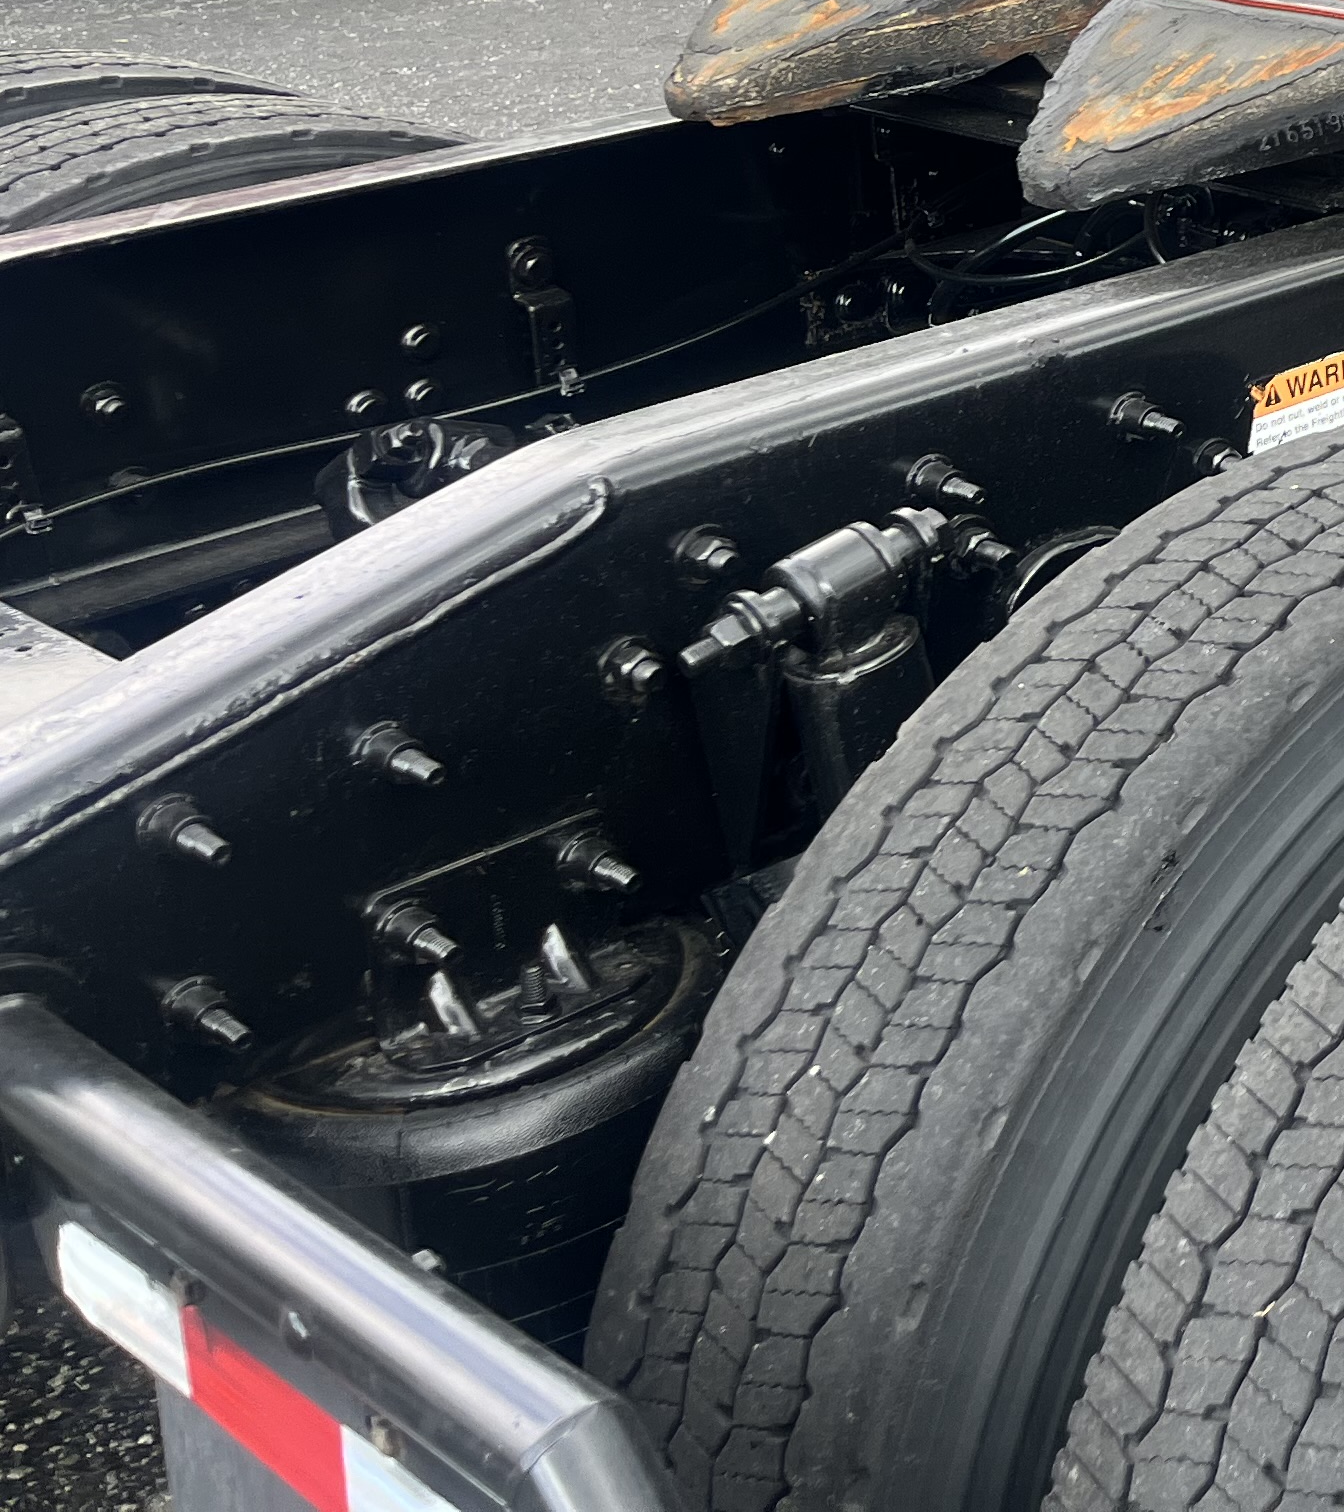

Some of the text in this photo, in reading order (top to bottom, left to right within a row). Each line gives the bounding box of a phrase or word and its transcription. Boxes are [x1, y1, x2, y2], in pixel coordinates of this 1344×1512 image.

[1255, 421, 1269, 433] Do
[1270, 415, 1286, 428] not
[1307, 400, 1329, 416] weld
[1331, 397, 1341, 407] or
[1295, 422, 1310, 434] the
